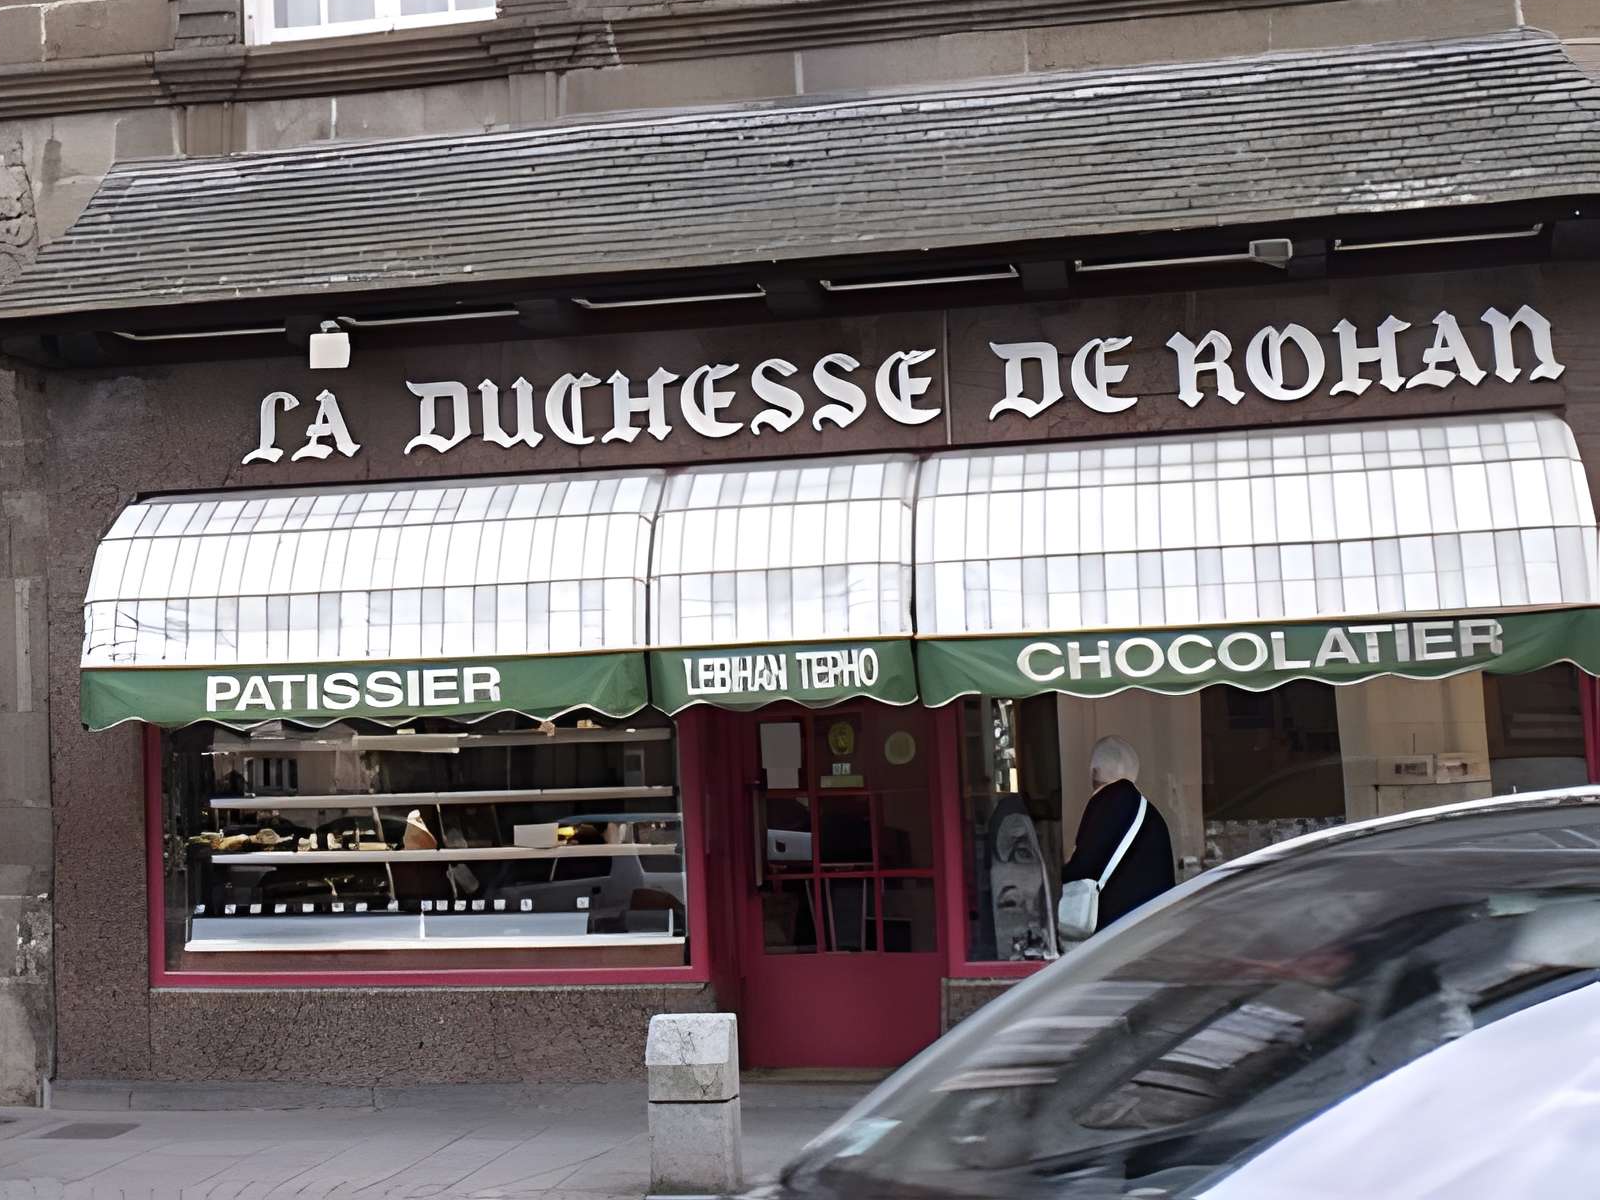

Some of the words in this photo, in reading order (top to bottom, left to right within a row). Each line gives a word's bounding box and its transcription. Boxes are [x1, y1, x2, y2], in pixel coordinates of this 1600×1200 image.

[241, 388, 361, 465] LA
[403, 348, 942, 456] DUCHESSE
[988, 335, 1139, 421] DE
[1165, 304, 1566, 409] ROHAN
[1016, 618, 1504, 683] CHOCOLATIER
[205, 666, 501, 712] PATISSIER
